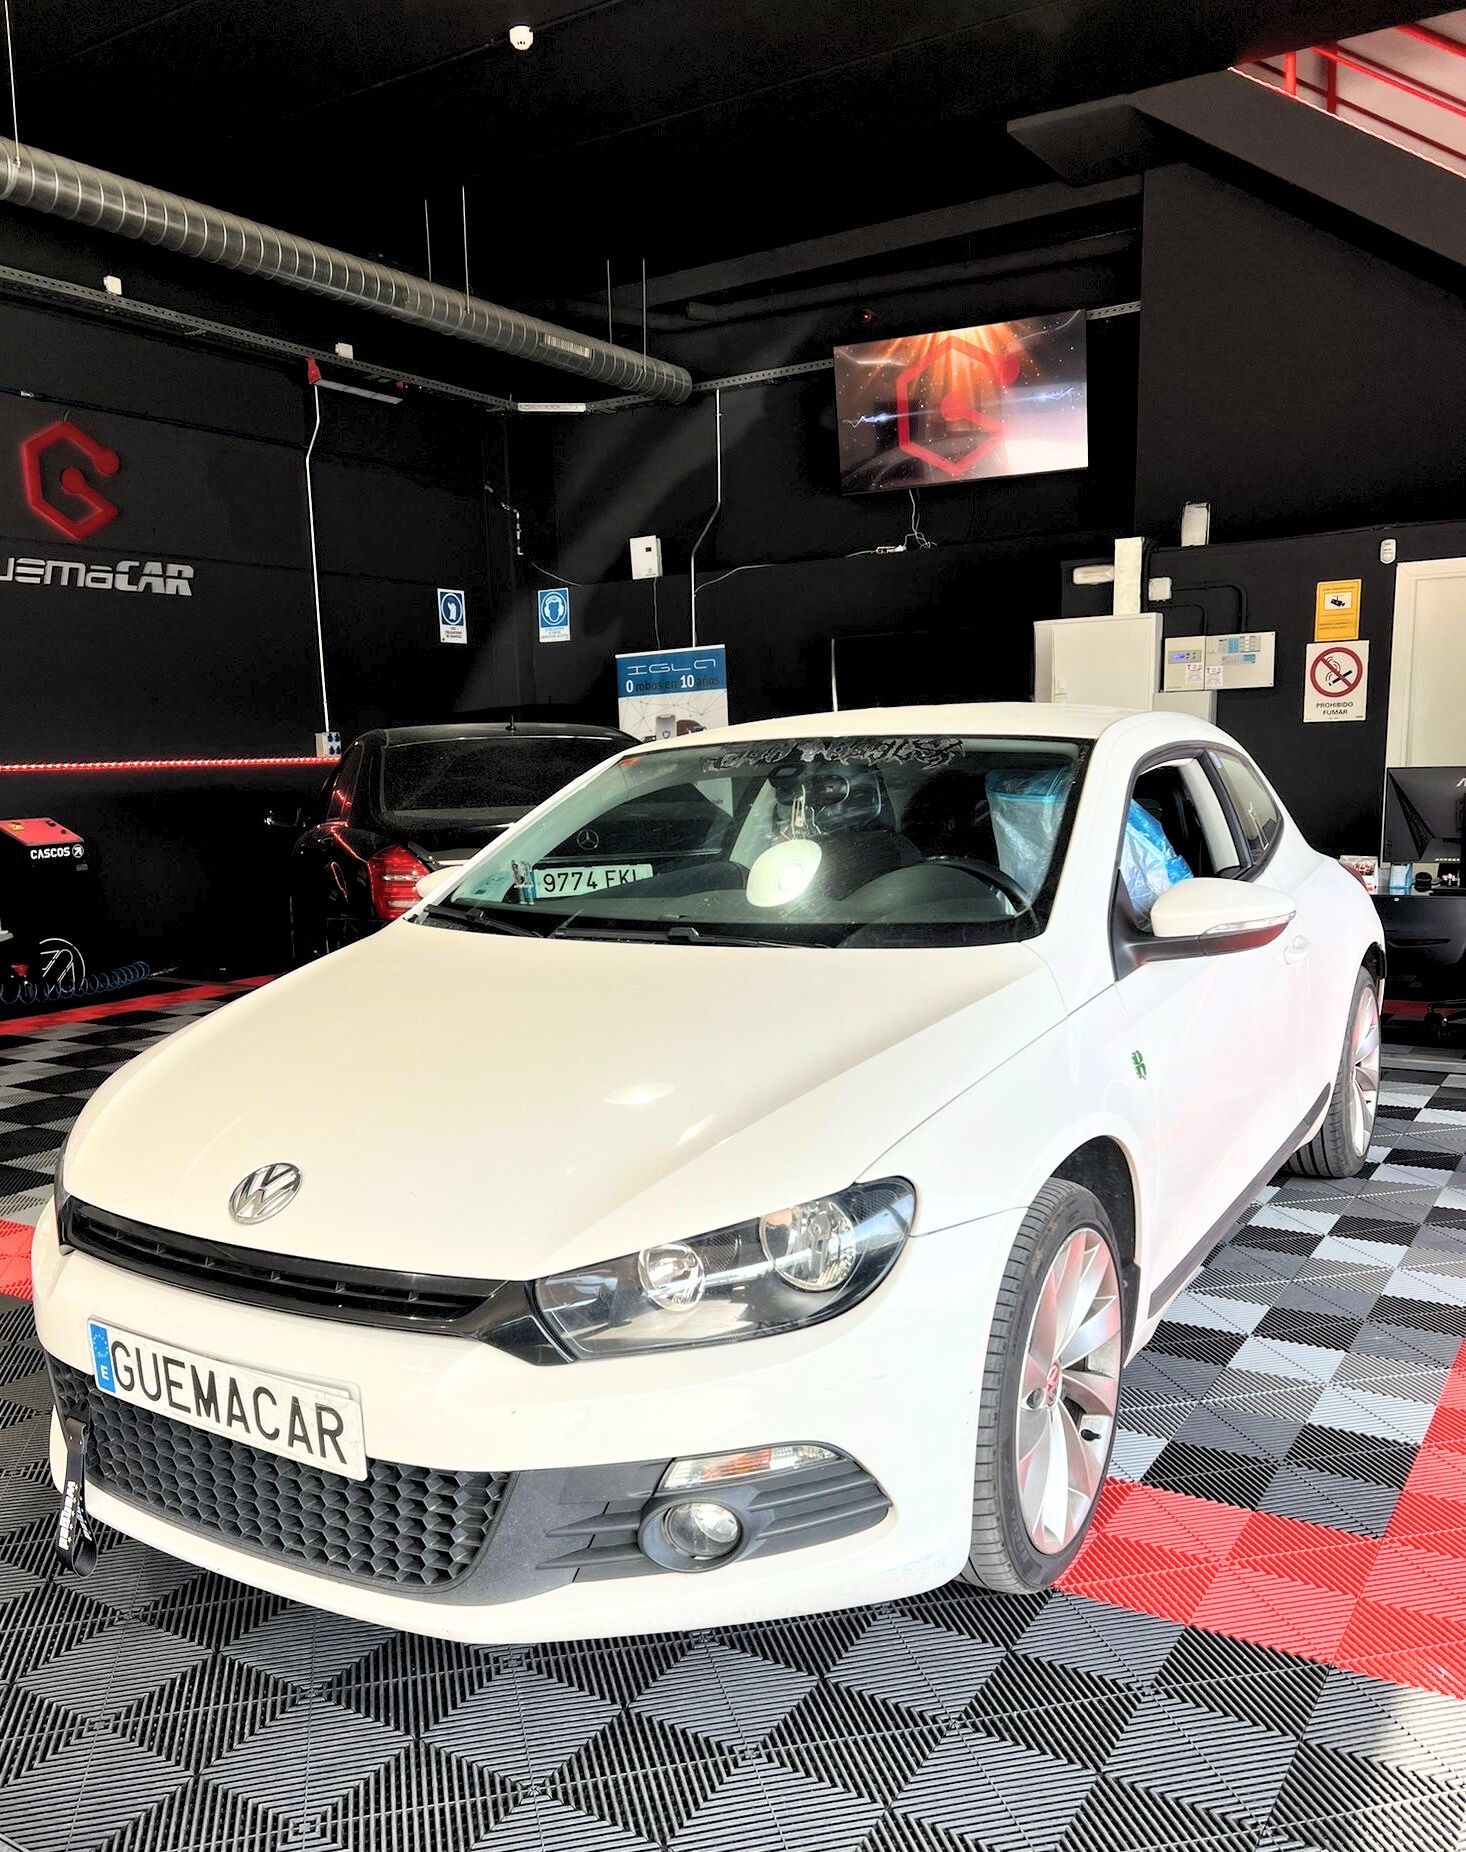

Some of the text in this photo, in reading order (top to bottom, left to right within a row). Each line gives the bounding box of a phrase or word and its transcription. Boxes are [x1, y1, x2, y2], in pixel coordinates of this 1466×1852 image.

[625, 674, 720, 693] 0 robos en 10 años
[1316, 701, 1354, 709] PROHIBIDO
[30, 847, 71, 860] CASCOS
[543, 870, 598, 893] 9774
[100, 1364, 109, 1381] E
[110, 1340, 347, 1464] GUEMACAR
